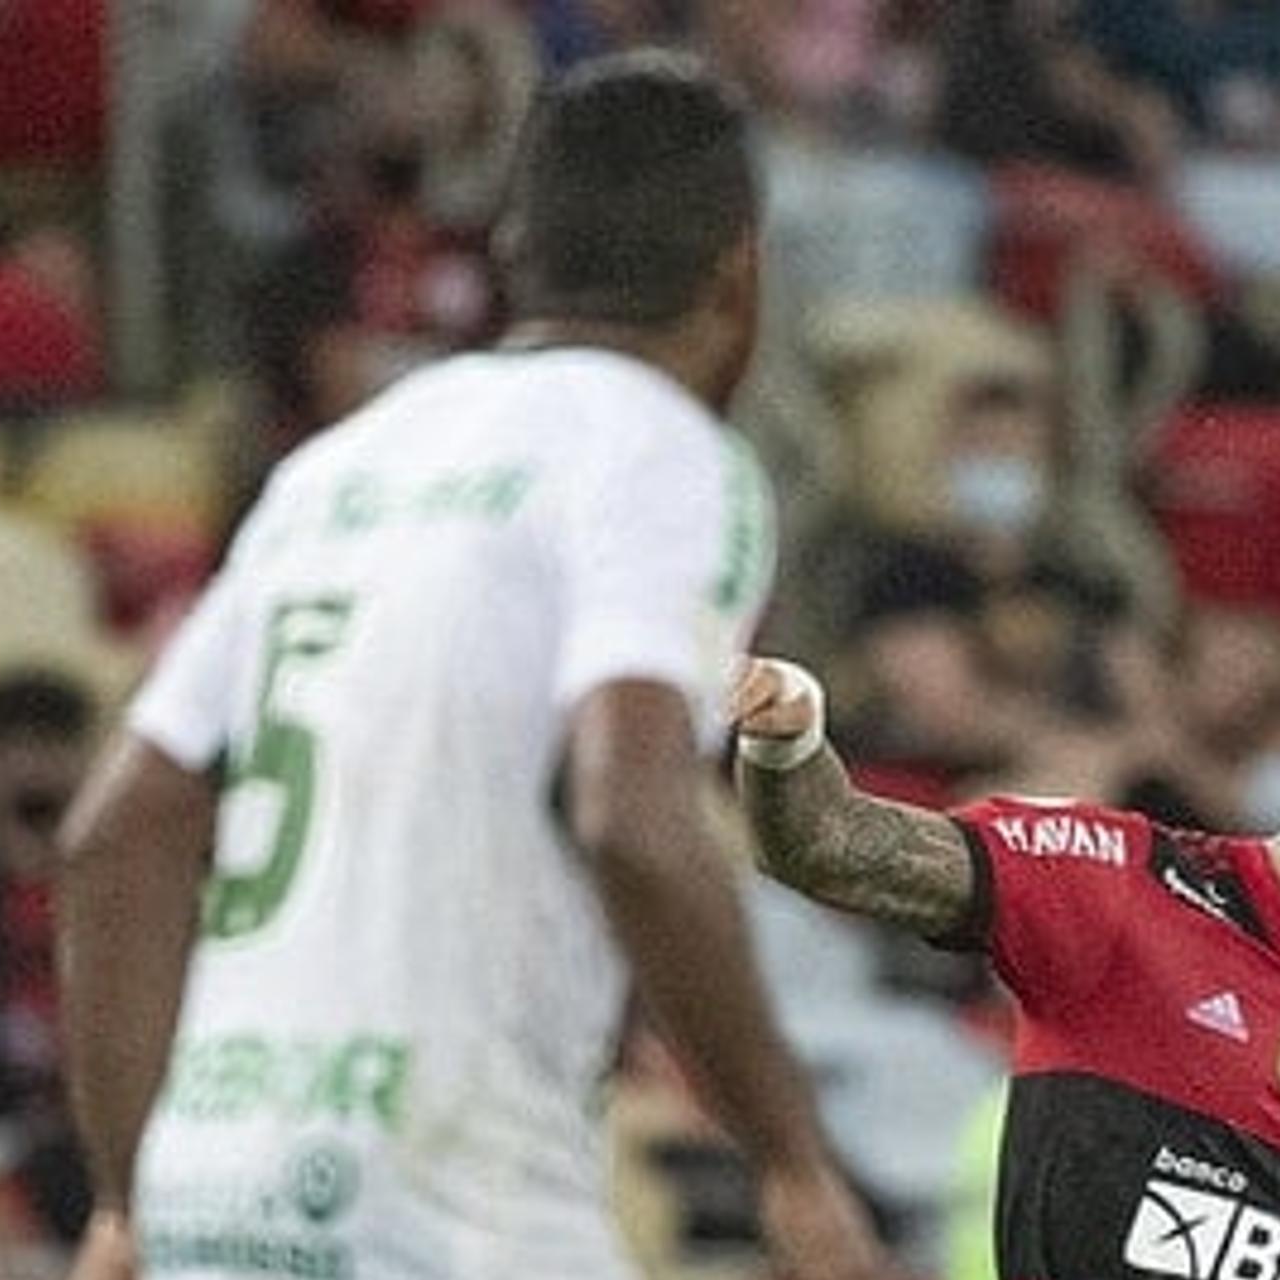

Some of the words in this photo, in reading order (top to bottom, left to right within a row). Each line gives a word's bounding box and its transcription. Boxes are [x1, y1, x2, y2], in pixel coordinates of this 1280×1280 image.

[208, 594, 352, 938] 5
[993, 816, 1127, 869] HAVAN
[1154, 1146, 1248, 1194] banco
